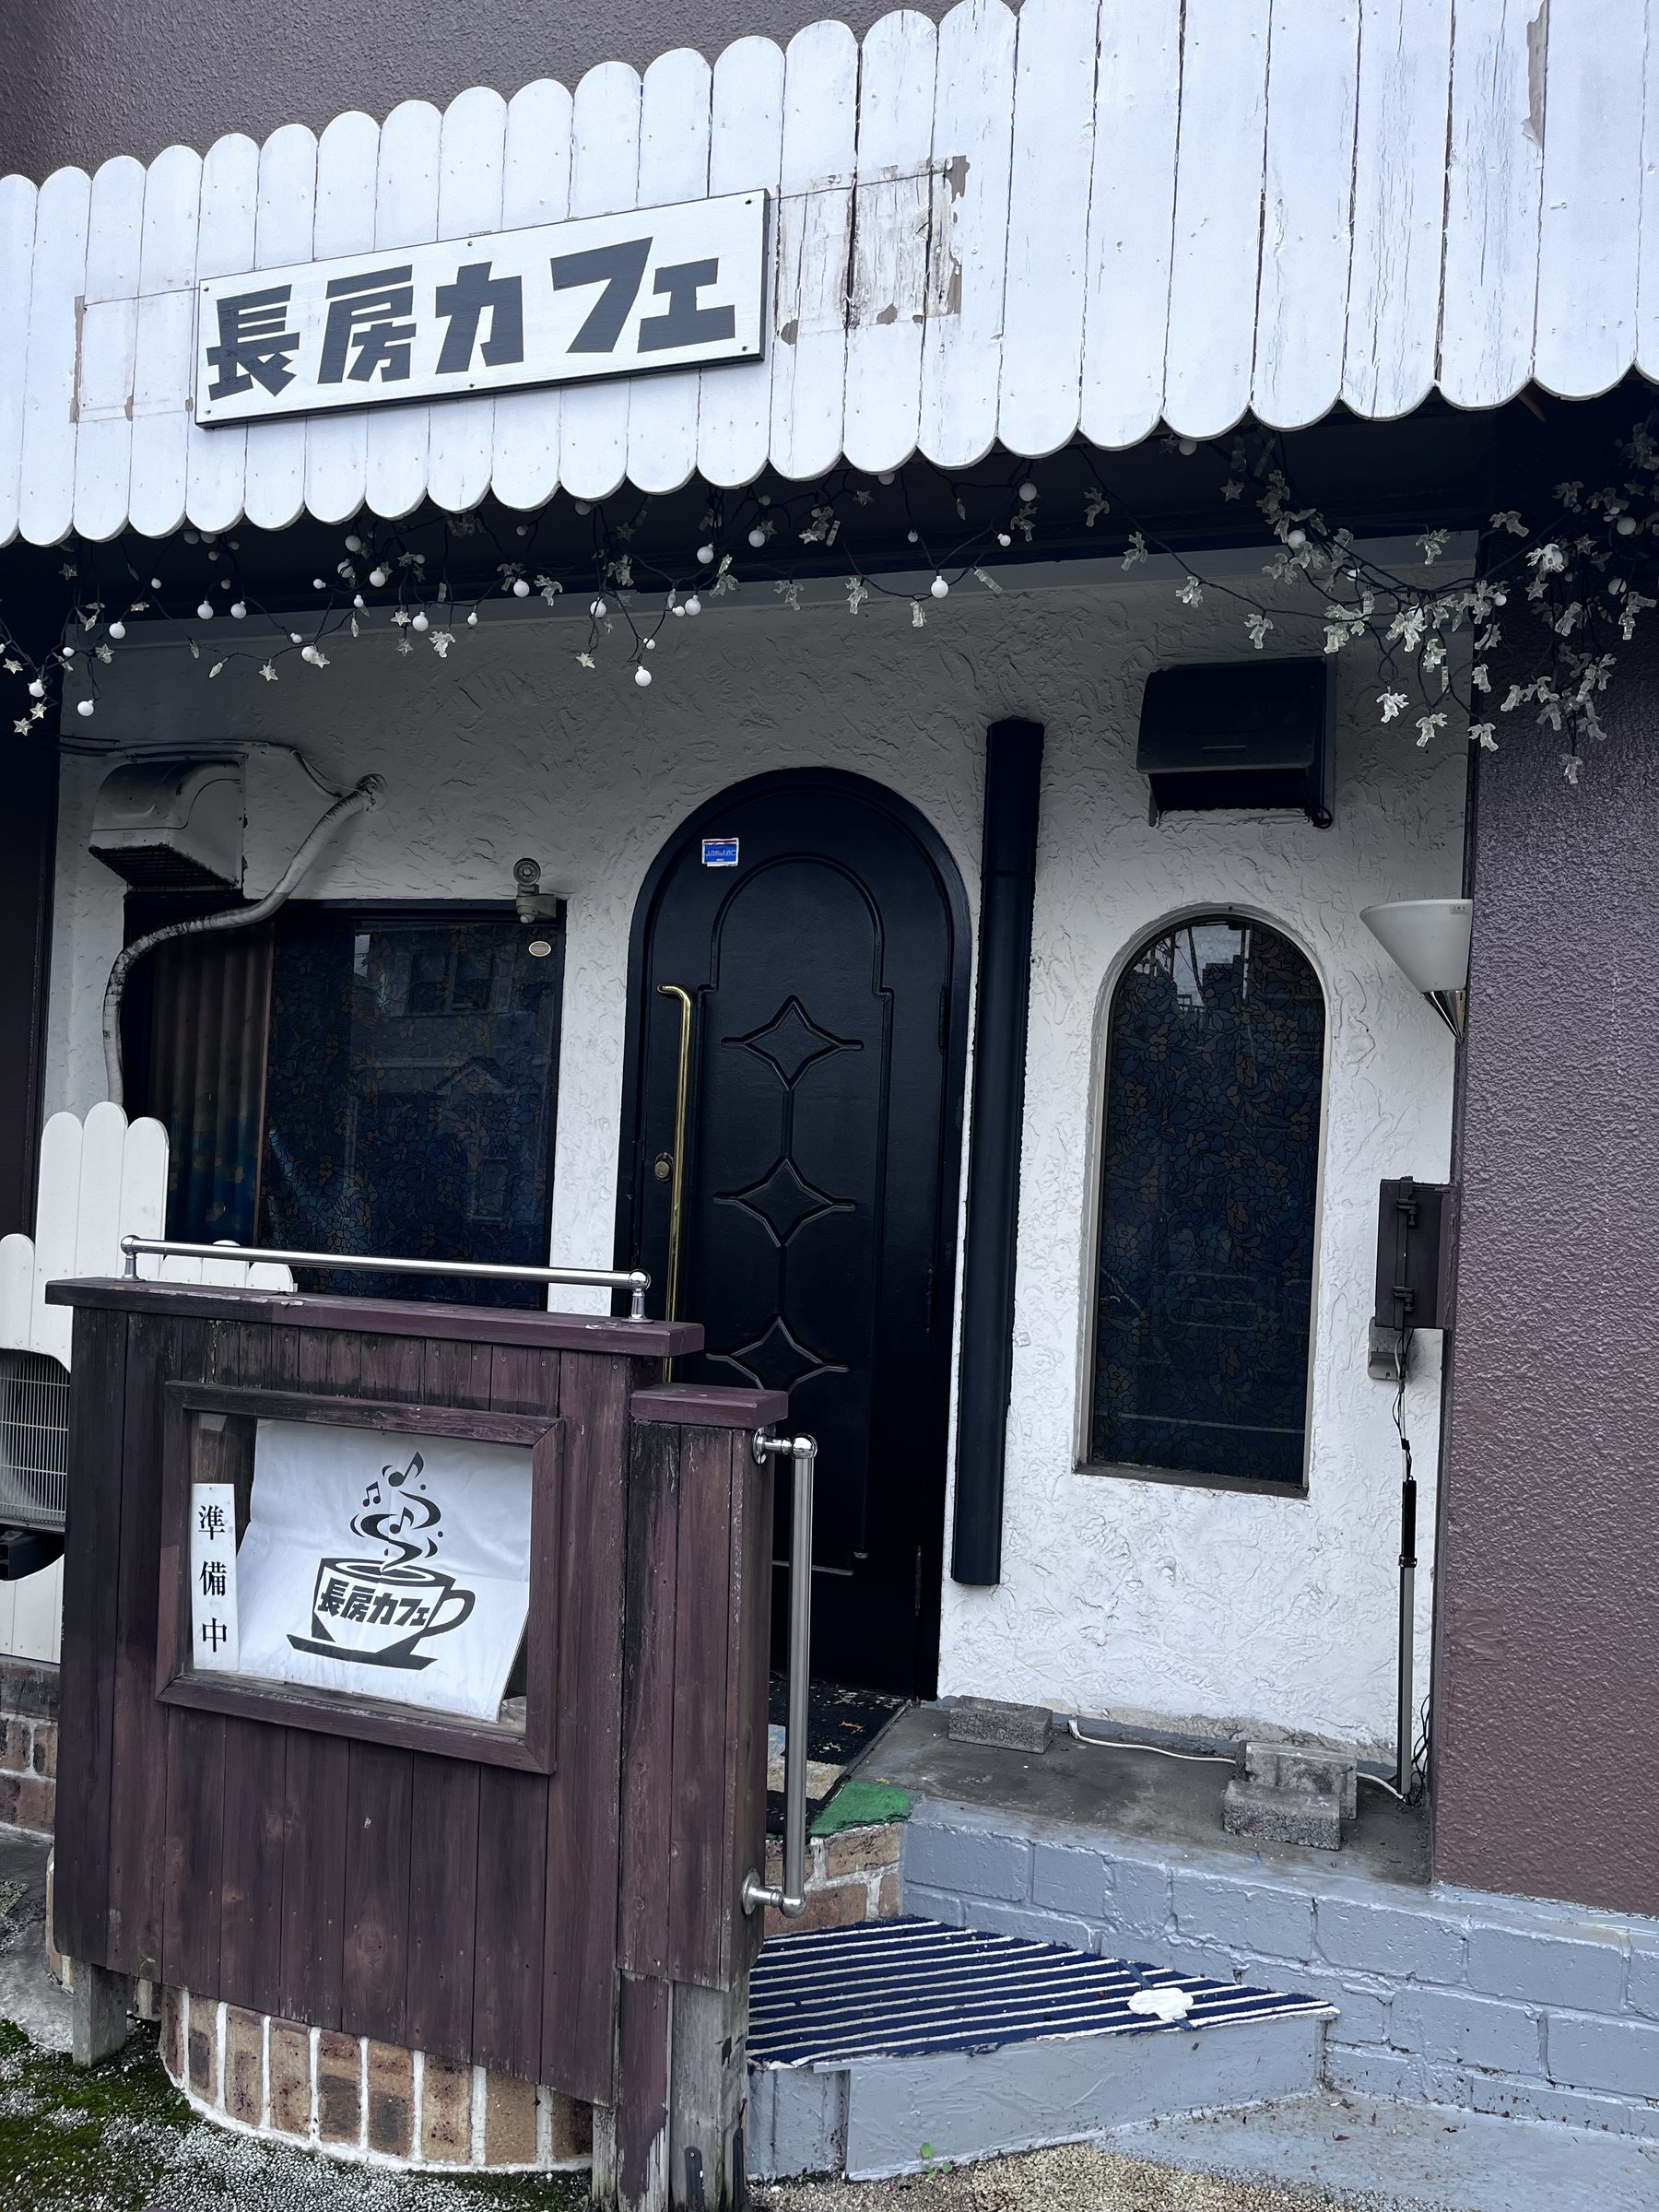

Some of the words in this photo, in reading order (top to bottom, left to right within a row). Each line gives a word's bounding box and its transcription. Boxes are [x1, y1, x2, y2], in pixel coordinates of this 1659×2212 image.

[206, 236, 736, 402] 長房カフェ
[198, 1504, 229, 1653] 準備中
[317, 1578, 431, 1627] 長房カフェ
